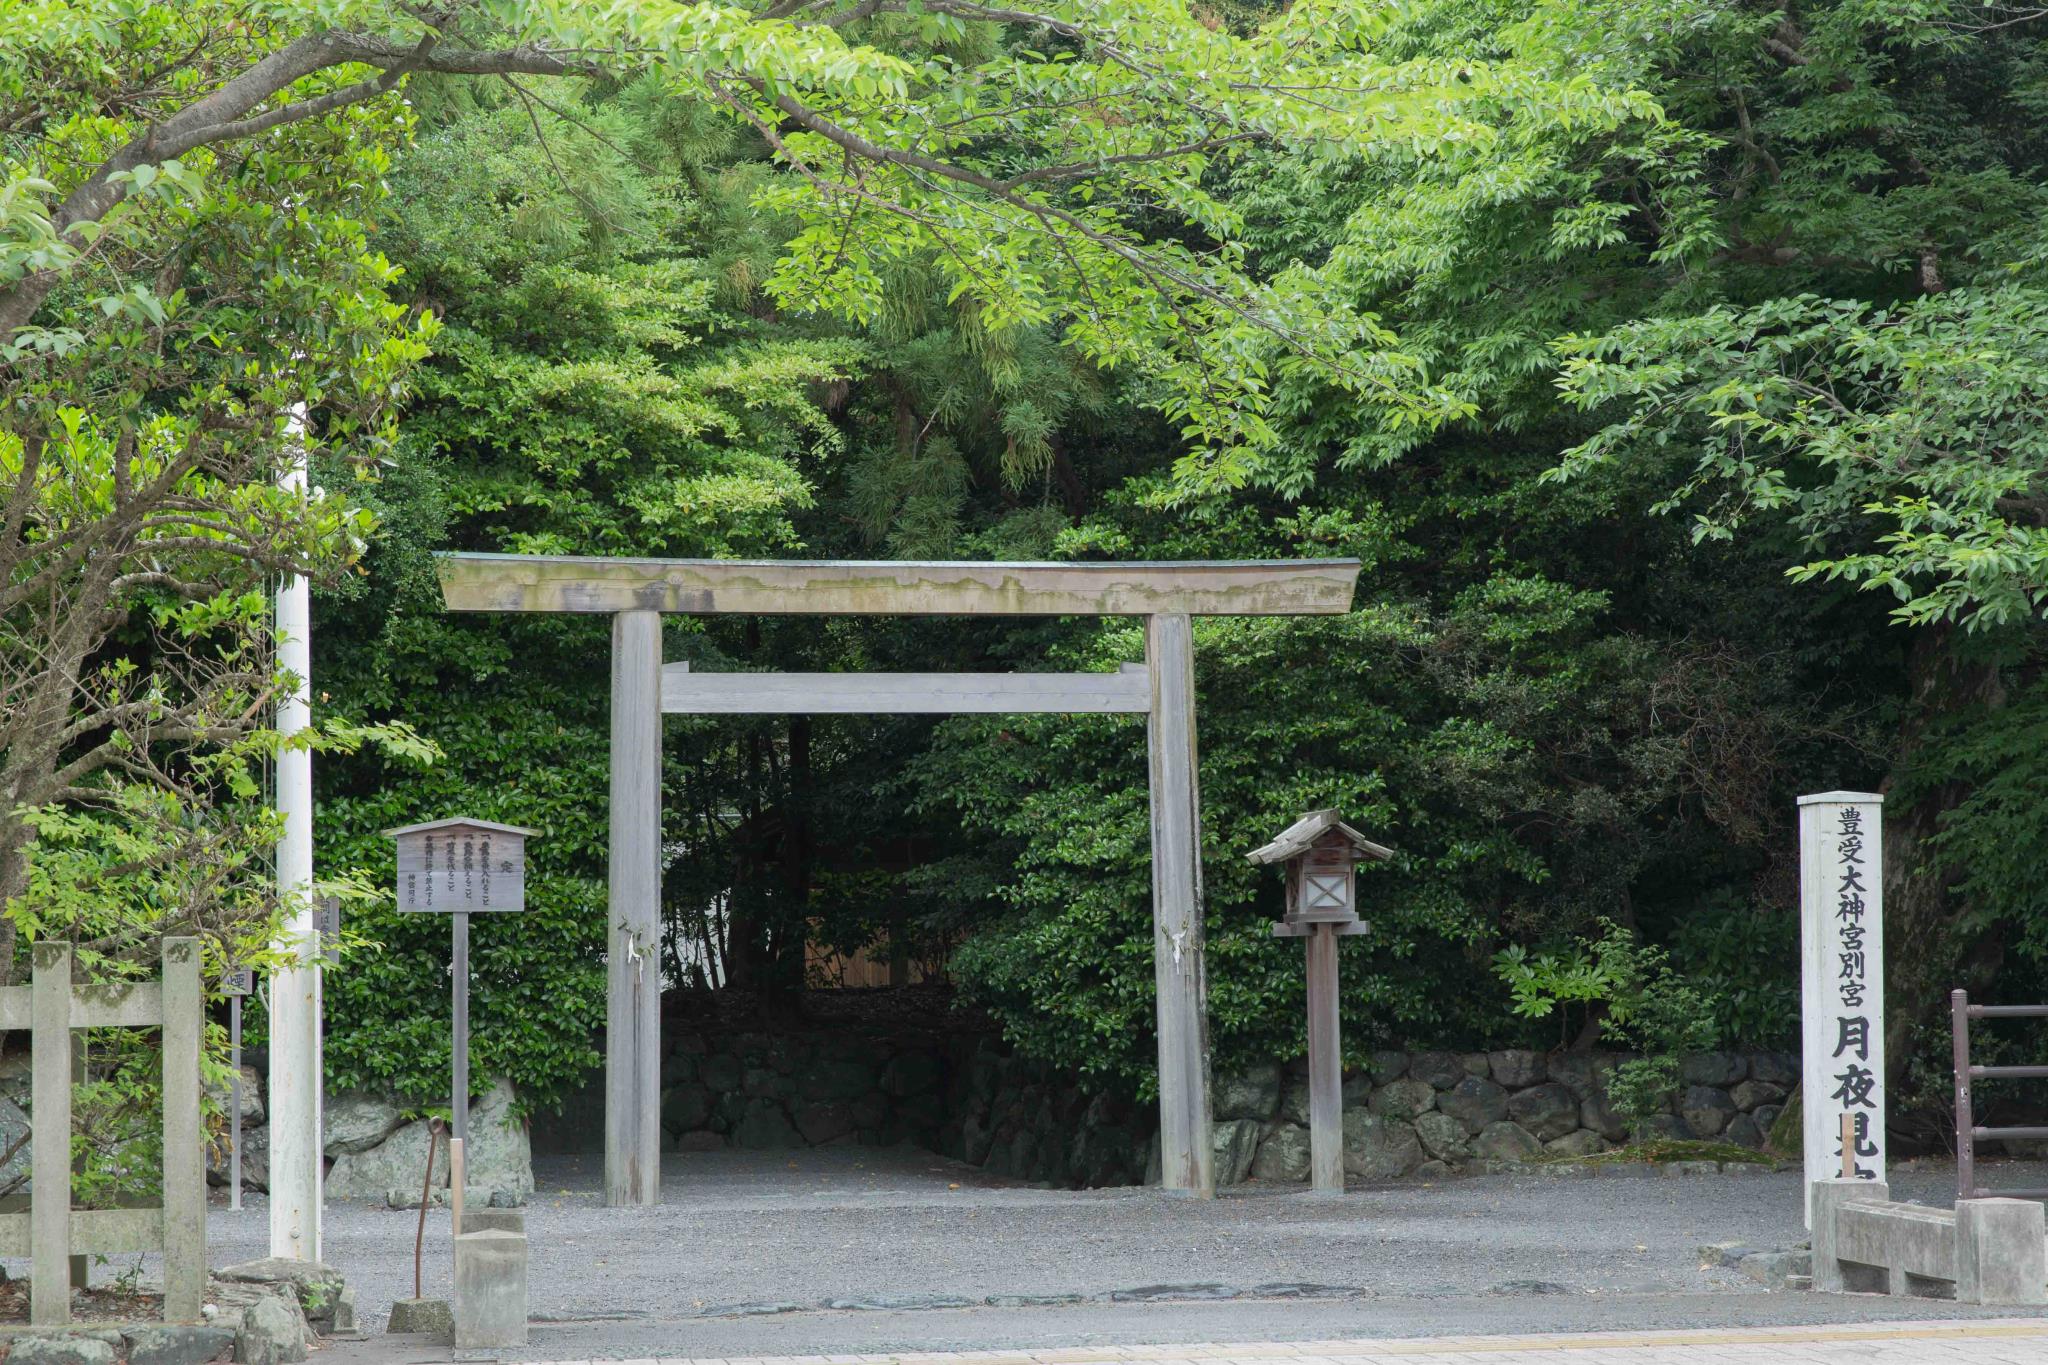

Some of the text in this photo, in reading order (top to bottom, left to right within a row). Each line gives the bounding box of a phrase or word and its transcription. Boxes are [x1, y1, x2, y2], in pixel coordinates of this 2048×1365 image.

[500, 860, 514, 873] 定
[1830, 806, 1879, 1179] 豊受大神宮別宮 月夜見
